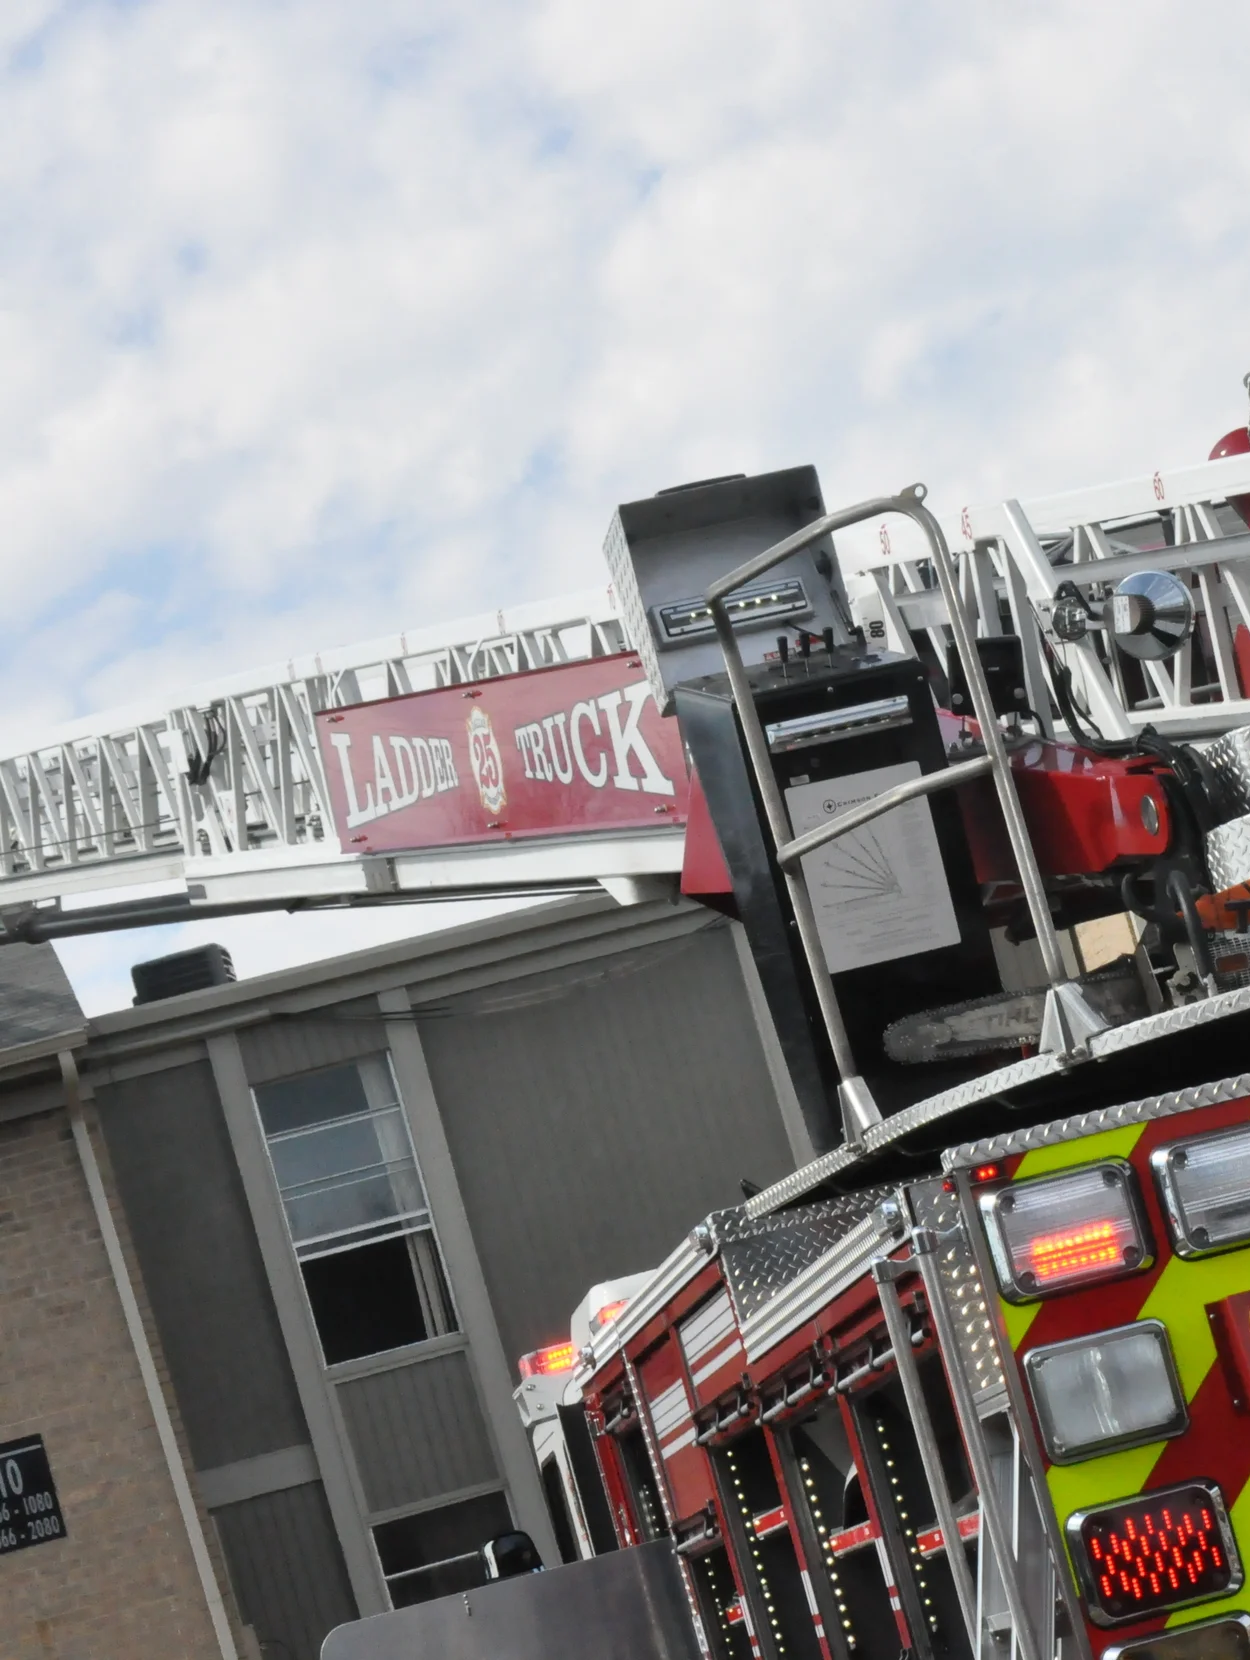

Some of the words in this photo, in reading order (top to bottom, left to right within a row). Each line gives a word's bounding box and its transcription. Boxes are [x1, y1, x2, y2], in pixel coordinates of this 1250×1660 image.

[1153, 478, 1165, 501] 60
[961, 514, 973, 540] 45
[879, 530, 891, 556] 50
[869, 620, 885, 638] 80
[331, 732, 460, 829] LADDER
[473, 734, 500, 789] 25
[515, 681, 675, 796] TRUCK
[23, 1491, 53, 1516] 1080
[27, 1515, 60, 1540] 2080
